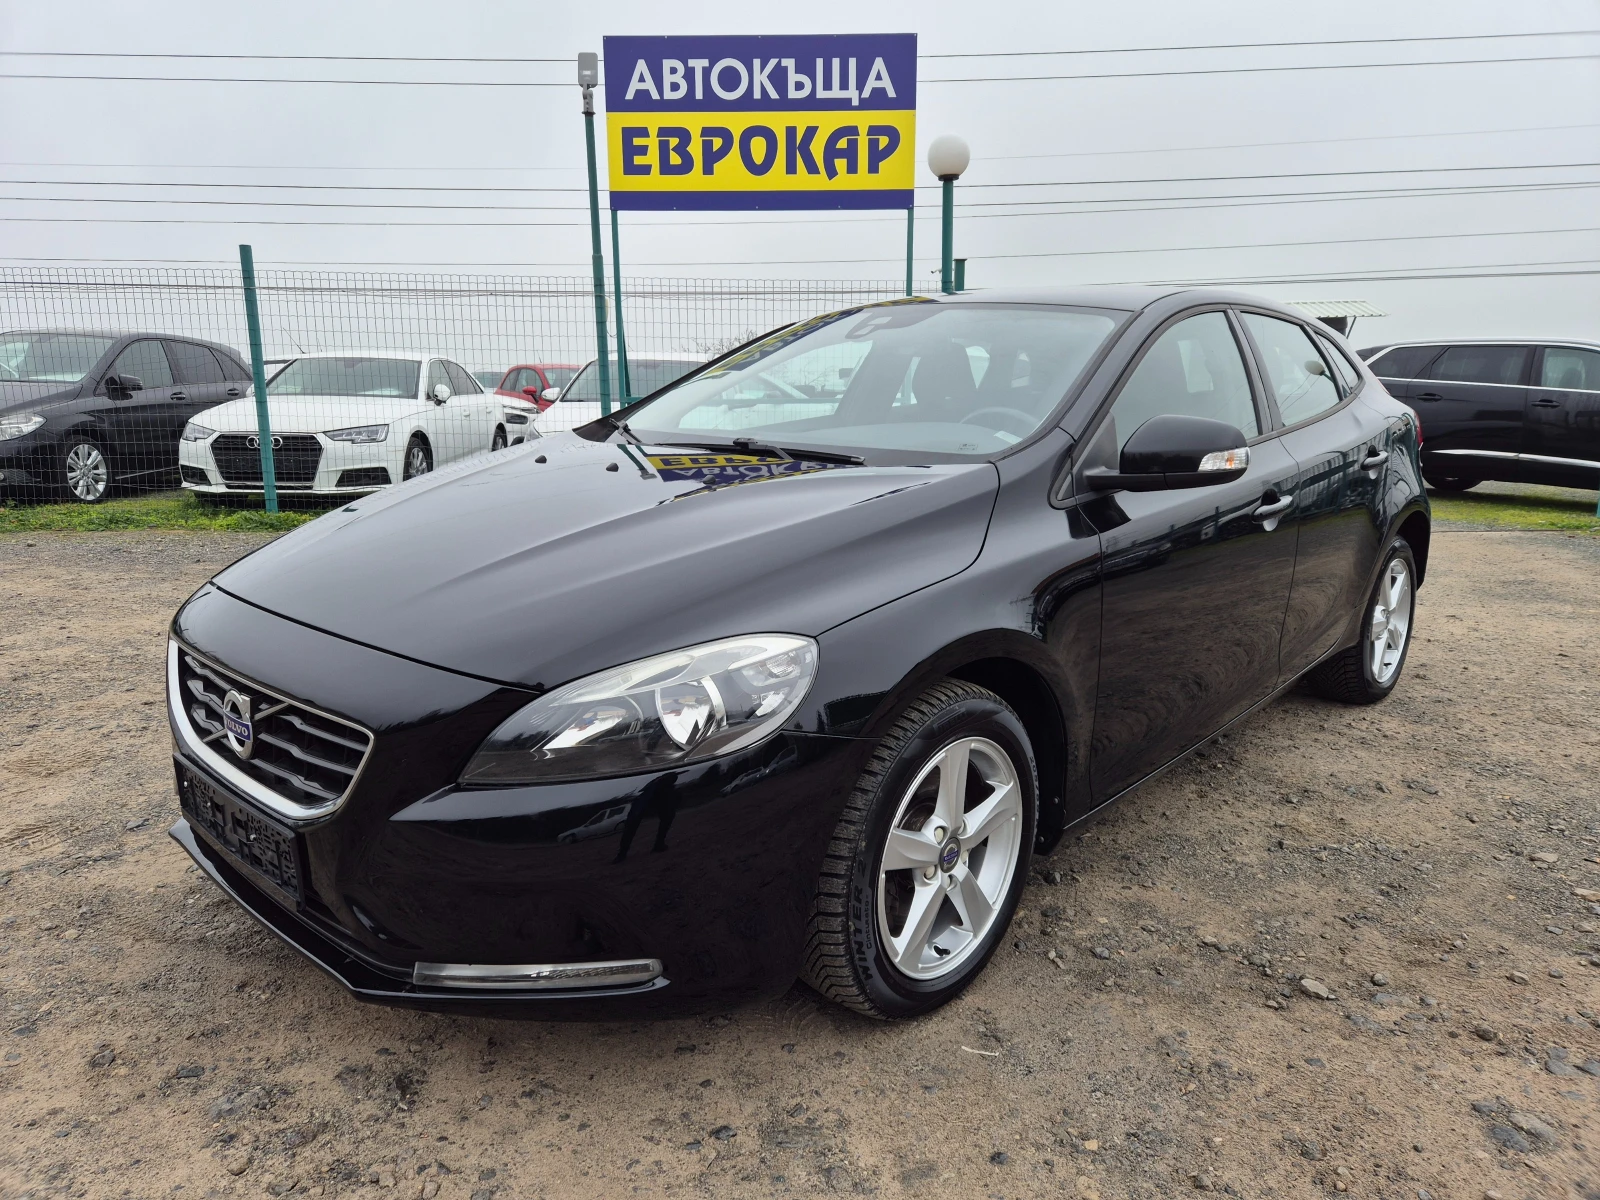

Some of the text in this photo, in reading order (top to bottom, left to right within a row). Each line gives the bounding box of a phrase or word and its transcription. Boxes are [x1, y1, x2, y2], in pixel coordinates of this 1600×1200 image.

[625, 57, 897, 106] АВТОКЪЩА
[621, 125, 901, 181] ЕВРОКАР
[851, 886, 873, 981] WINTER
